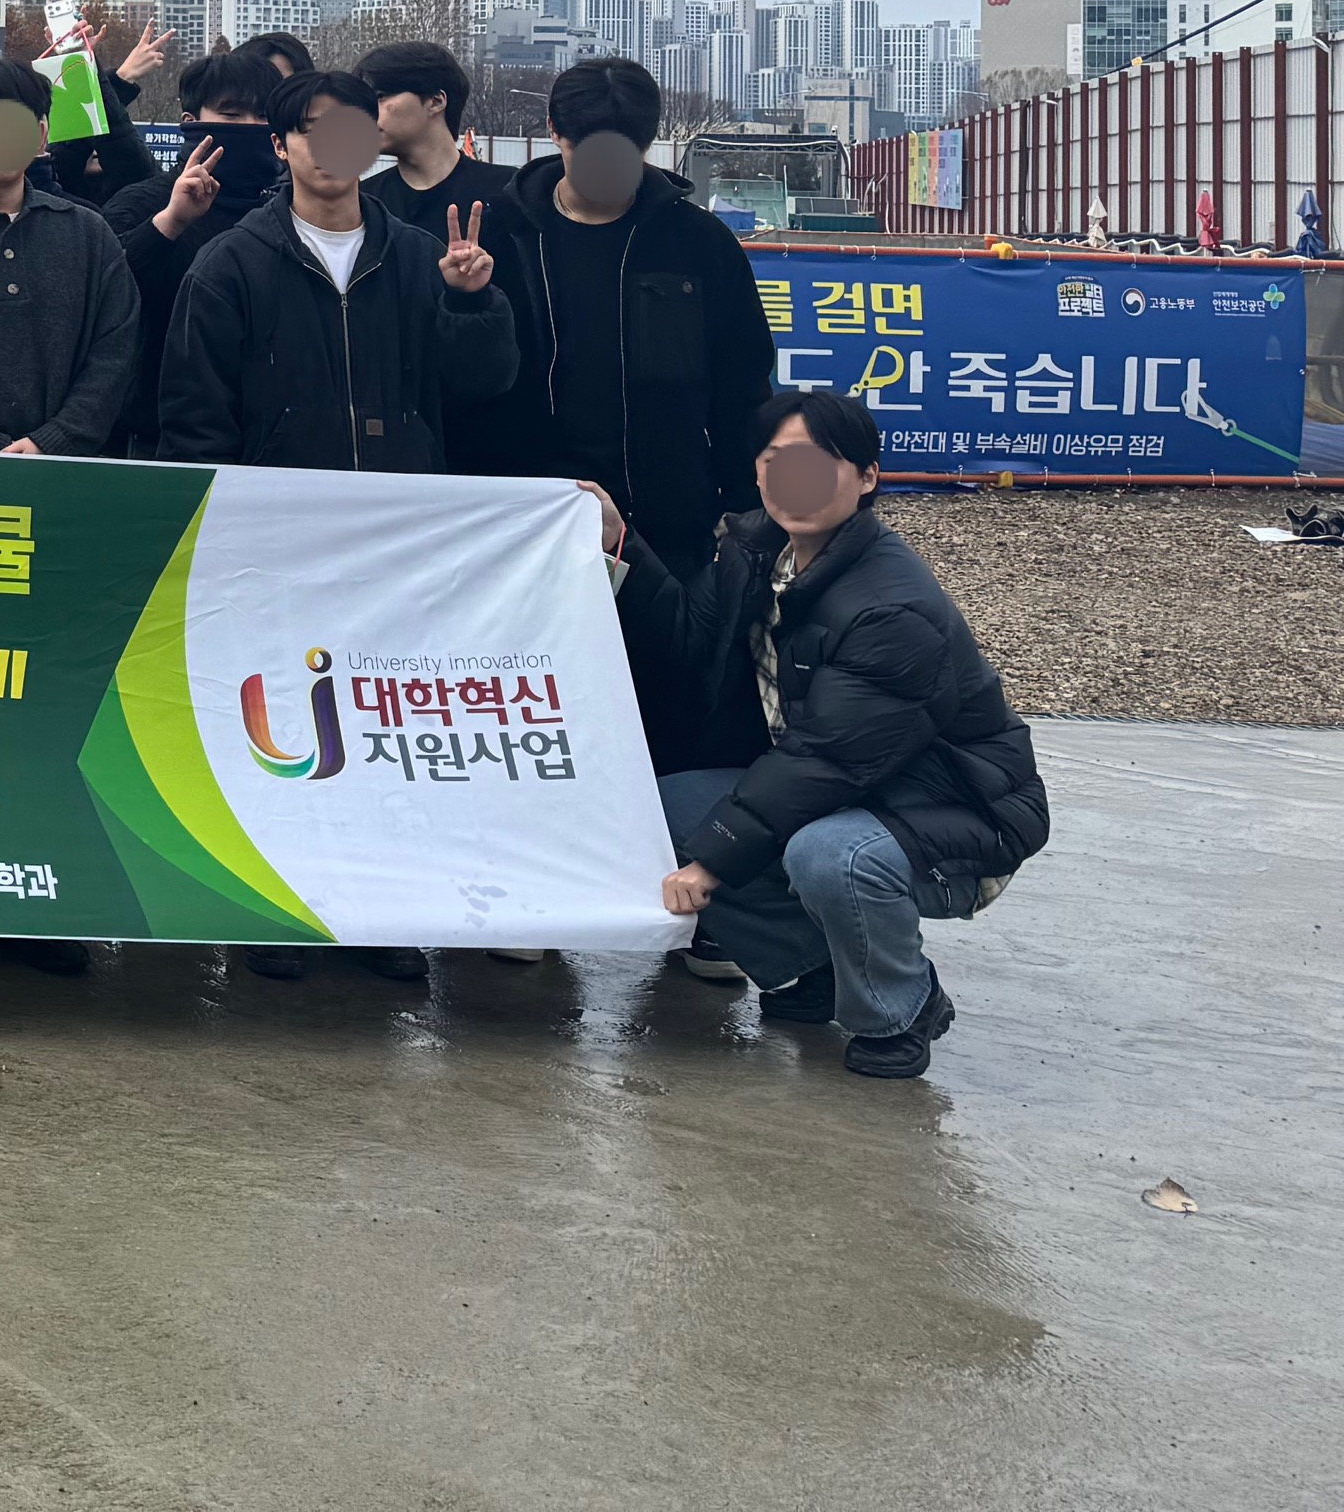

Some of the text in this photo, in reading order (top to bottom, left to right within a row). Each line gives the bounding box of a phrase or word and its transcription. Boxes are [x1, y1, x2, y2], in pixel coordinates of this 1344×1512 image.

[812, 281, 924, 336] 걸면
[1058, 297, 1105, 317] 프로젝트
[1149, 297, 1196, 310] 고용노동부
[1212, 299, 1266, 313] 안전보건공단
[948, 352, 1207, 418] 죽습니다
[891, 430, 948, 454] 안전대
[951, 432, 971, 454] 및
[975, 432, 1047, 455] 부속설비
[1052, 434, 1124, 456] 이상유무
[1128, 435, 1165, 457] 점검
[348, 650, 552, 676] University innovation
[351, 673, 564, 728] 대학혁신
[361, 729, 577, 782] 지원사업
